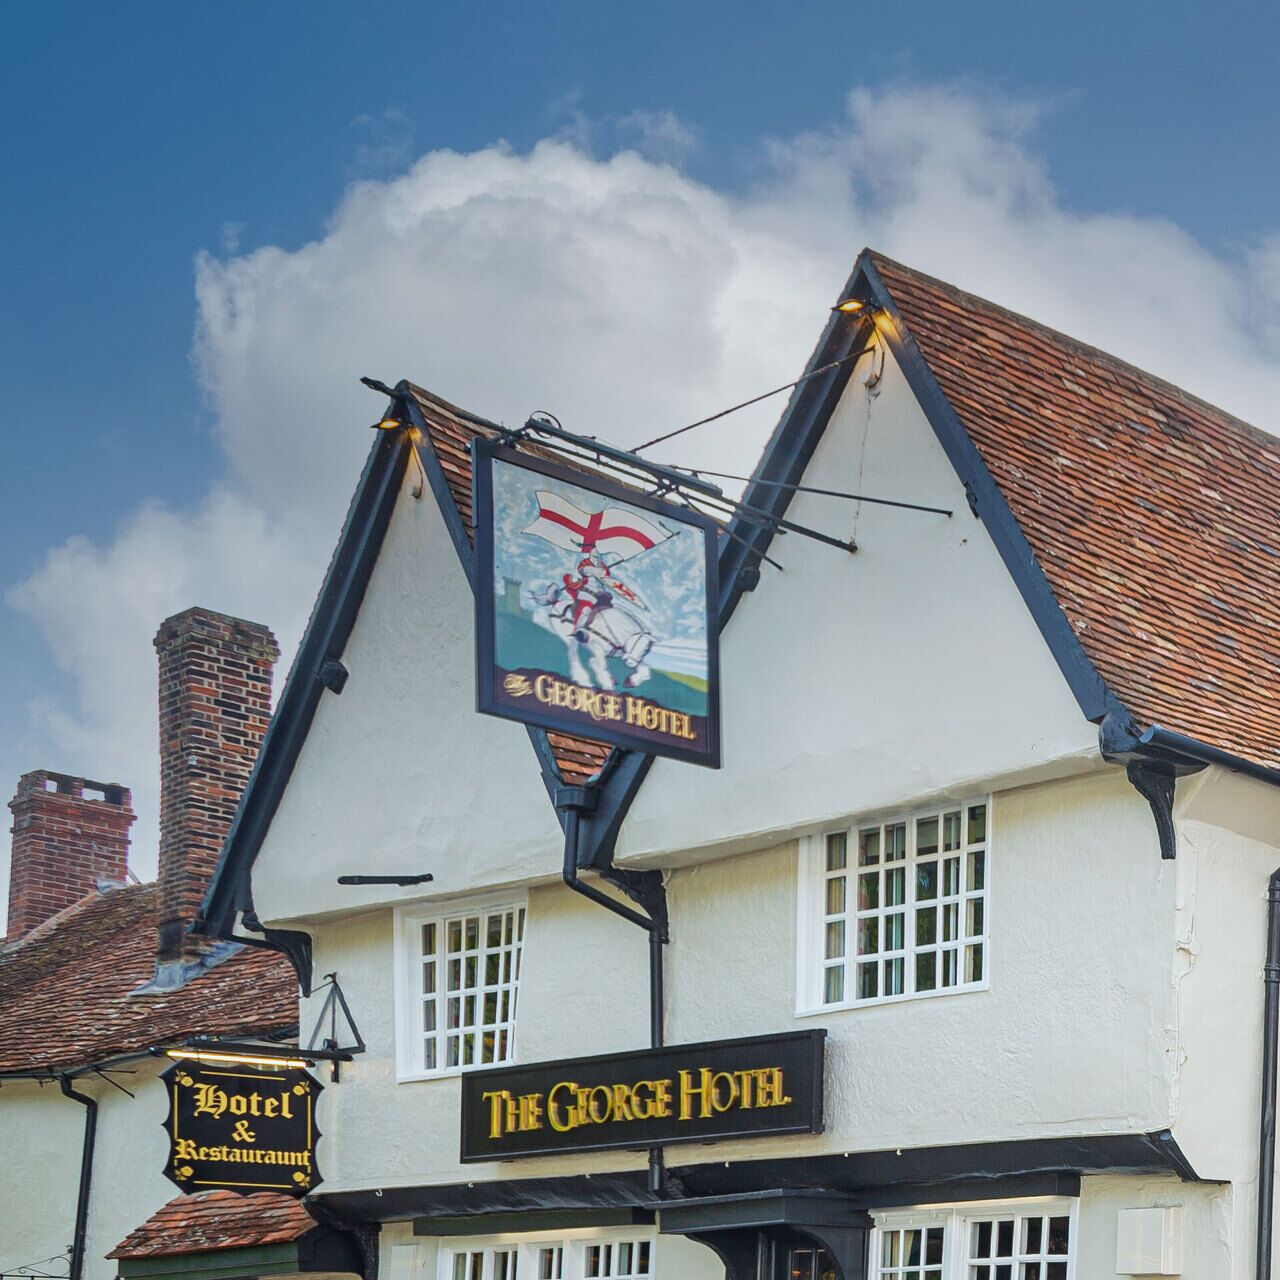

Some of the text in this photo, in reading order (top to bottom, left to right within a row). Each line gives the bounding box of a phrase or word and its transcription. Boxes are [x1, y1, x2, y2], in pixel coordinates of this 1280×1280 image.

[534, 675, 622, 721] GEORGE
[626, 697, 696, 740] HOTEL
[193, 1083, 294, 1119] Hotel
[482, 1067, 792, 1139] THE GEORGE HOTEL
[231, 1120, 256, 1143] &
